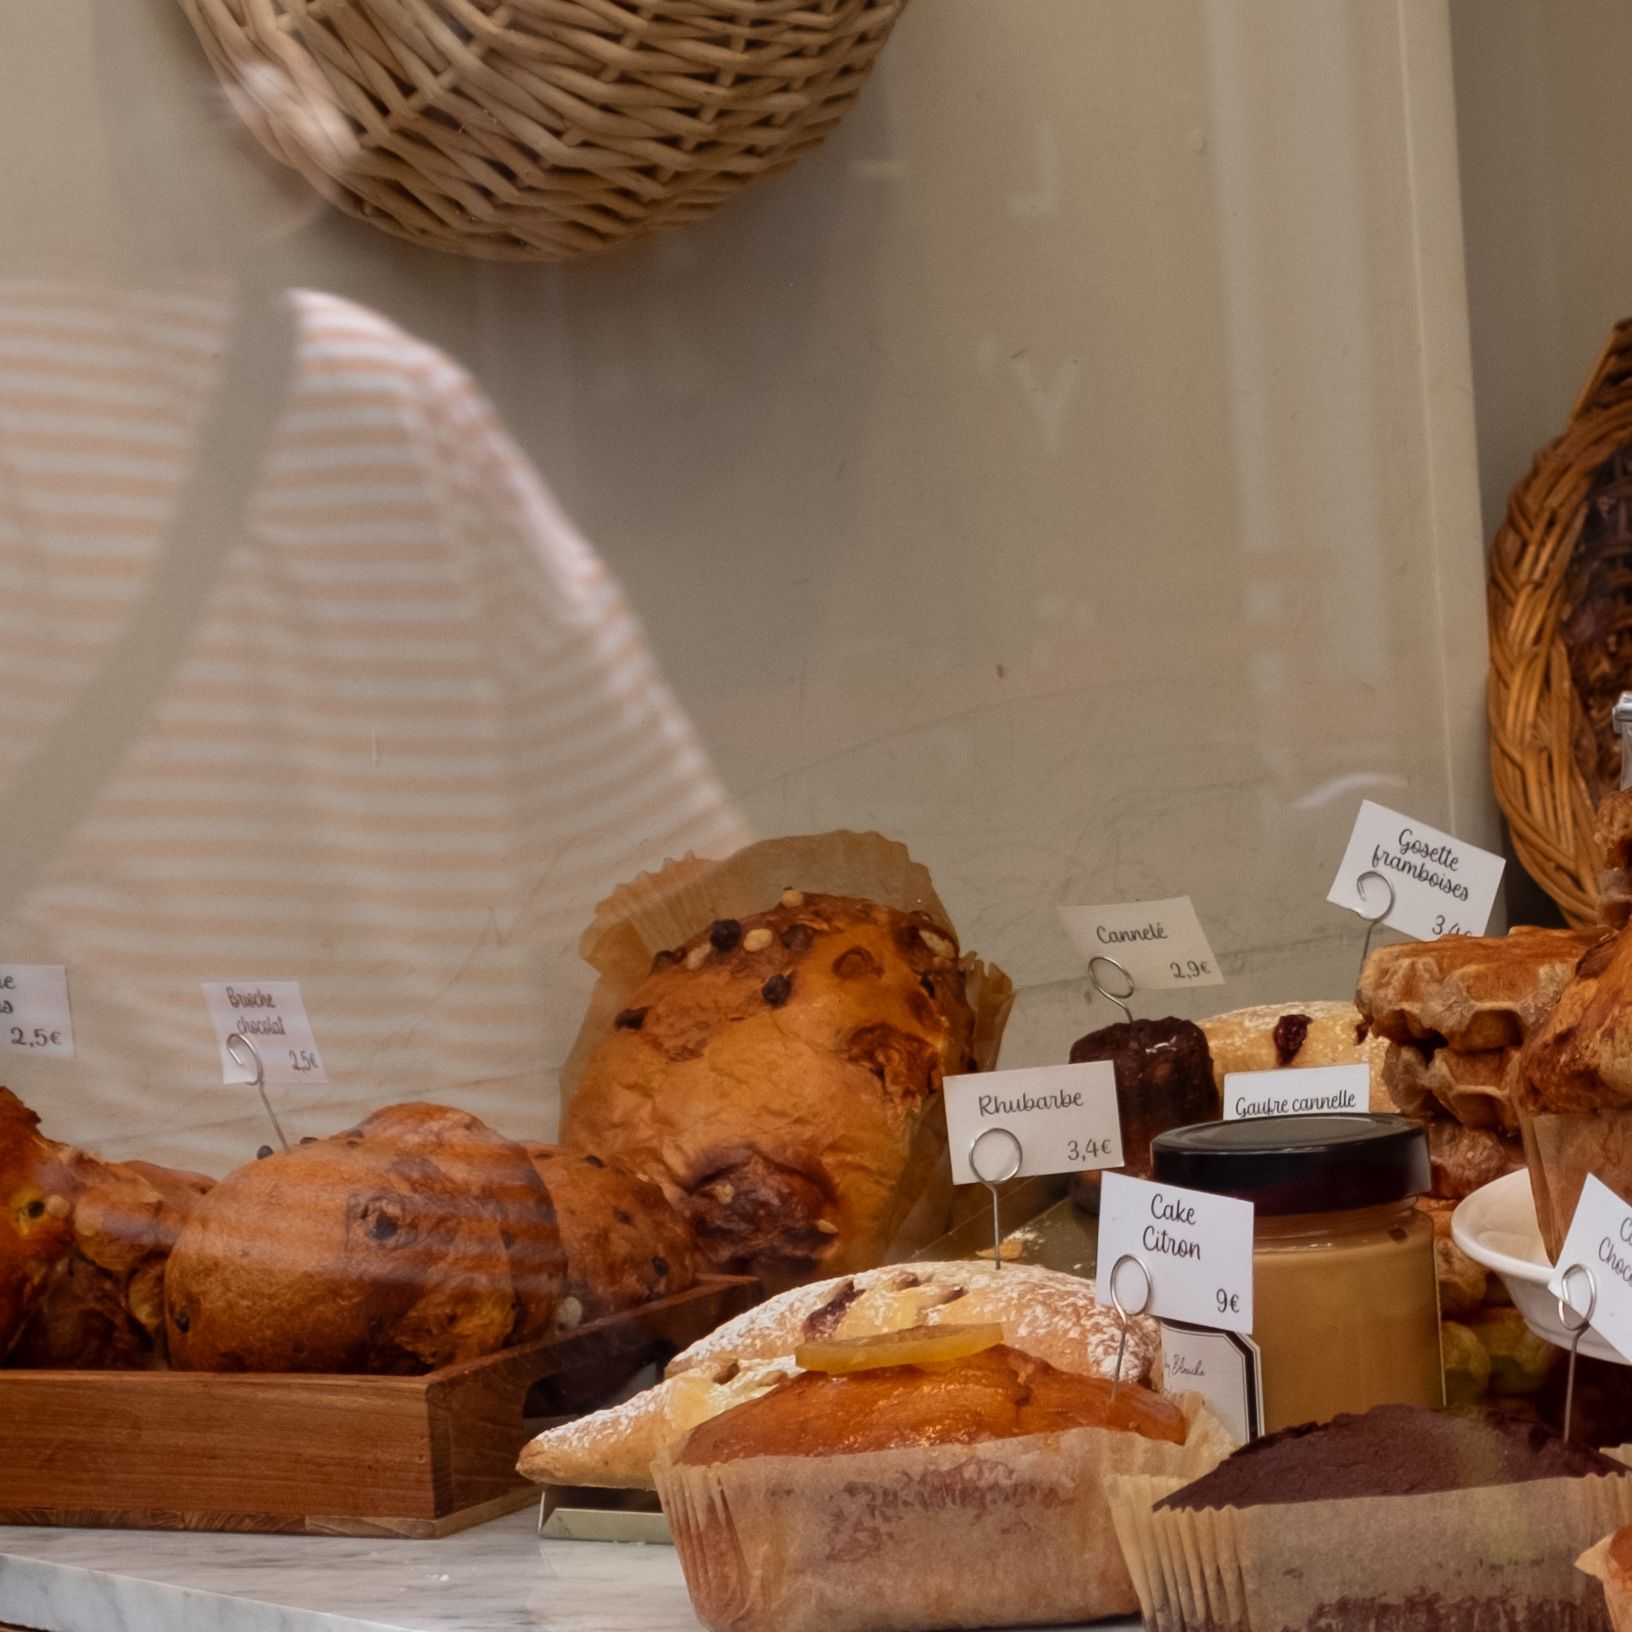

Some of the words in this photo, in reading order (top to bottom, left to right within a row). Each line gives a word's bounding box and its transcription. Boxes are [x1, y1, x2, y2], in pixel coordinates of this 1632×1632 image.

[1398, 828, 1460, 872] Gosette
[1371, 844, 1469, 902] framboises
[1096, 922, 1168, 945] Cannelé
[1169, 960, 1211, 981] 2,9€
[10, 1026, 63, 1048] 2,5€
[236, 1015, 287, 1036] chocolat
[978, 1089, 1085, 1117] Rhubarbe
[1235, 1096, 1290, 1119] Gaufre
[1291, 1089, 1357, 1112] cannelle
[1066, 1138, 1113, 1162] 3,4€
[1150, 1193, 1197, 1226] Cake
[1142, 1225, 1201, 1261] Citron
[1215, 1287, 1241, 1314] 9€
